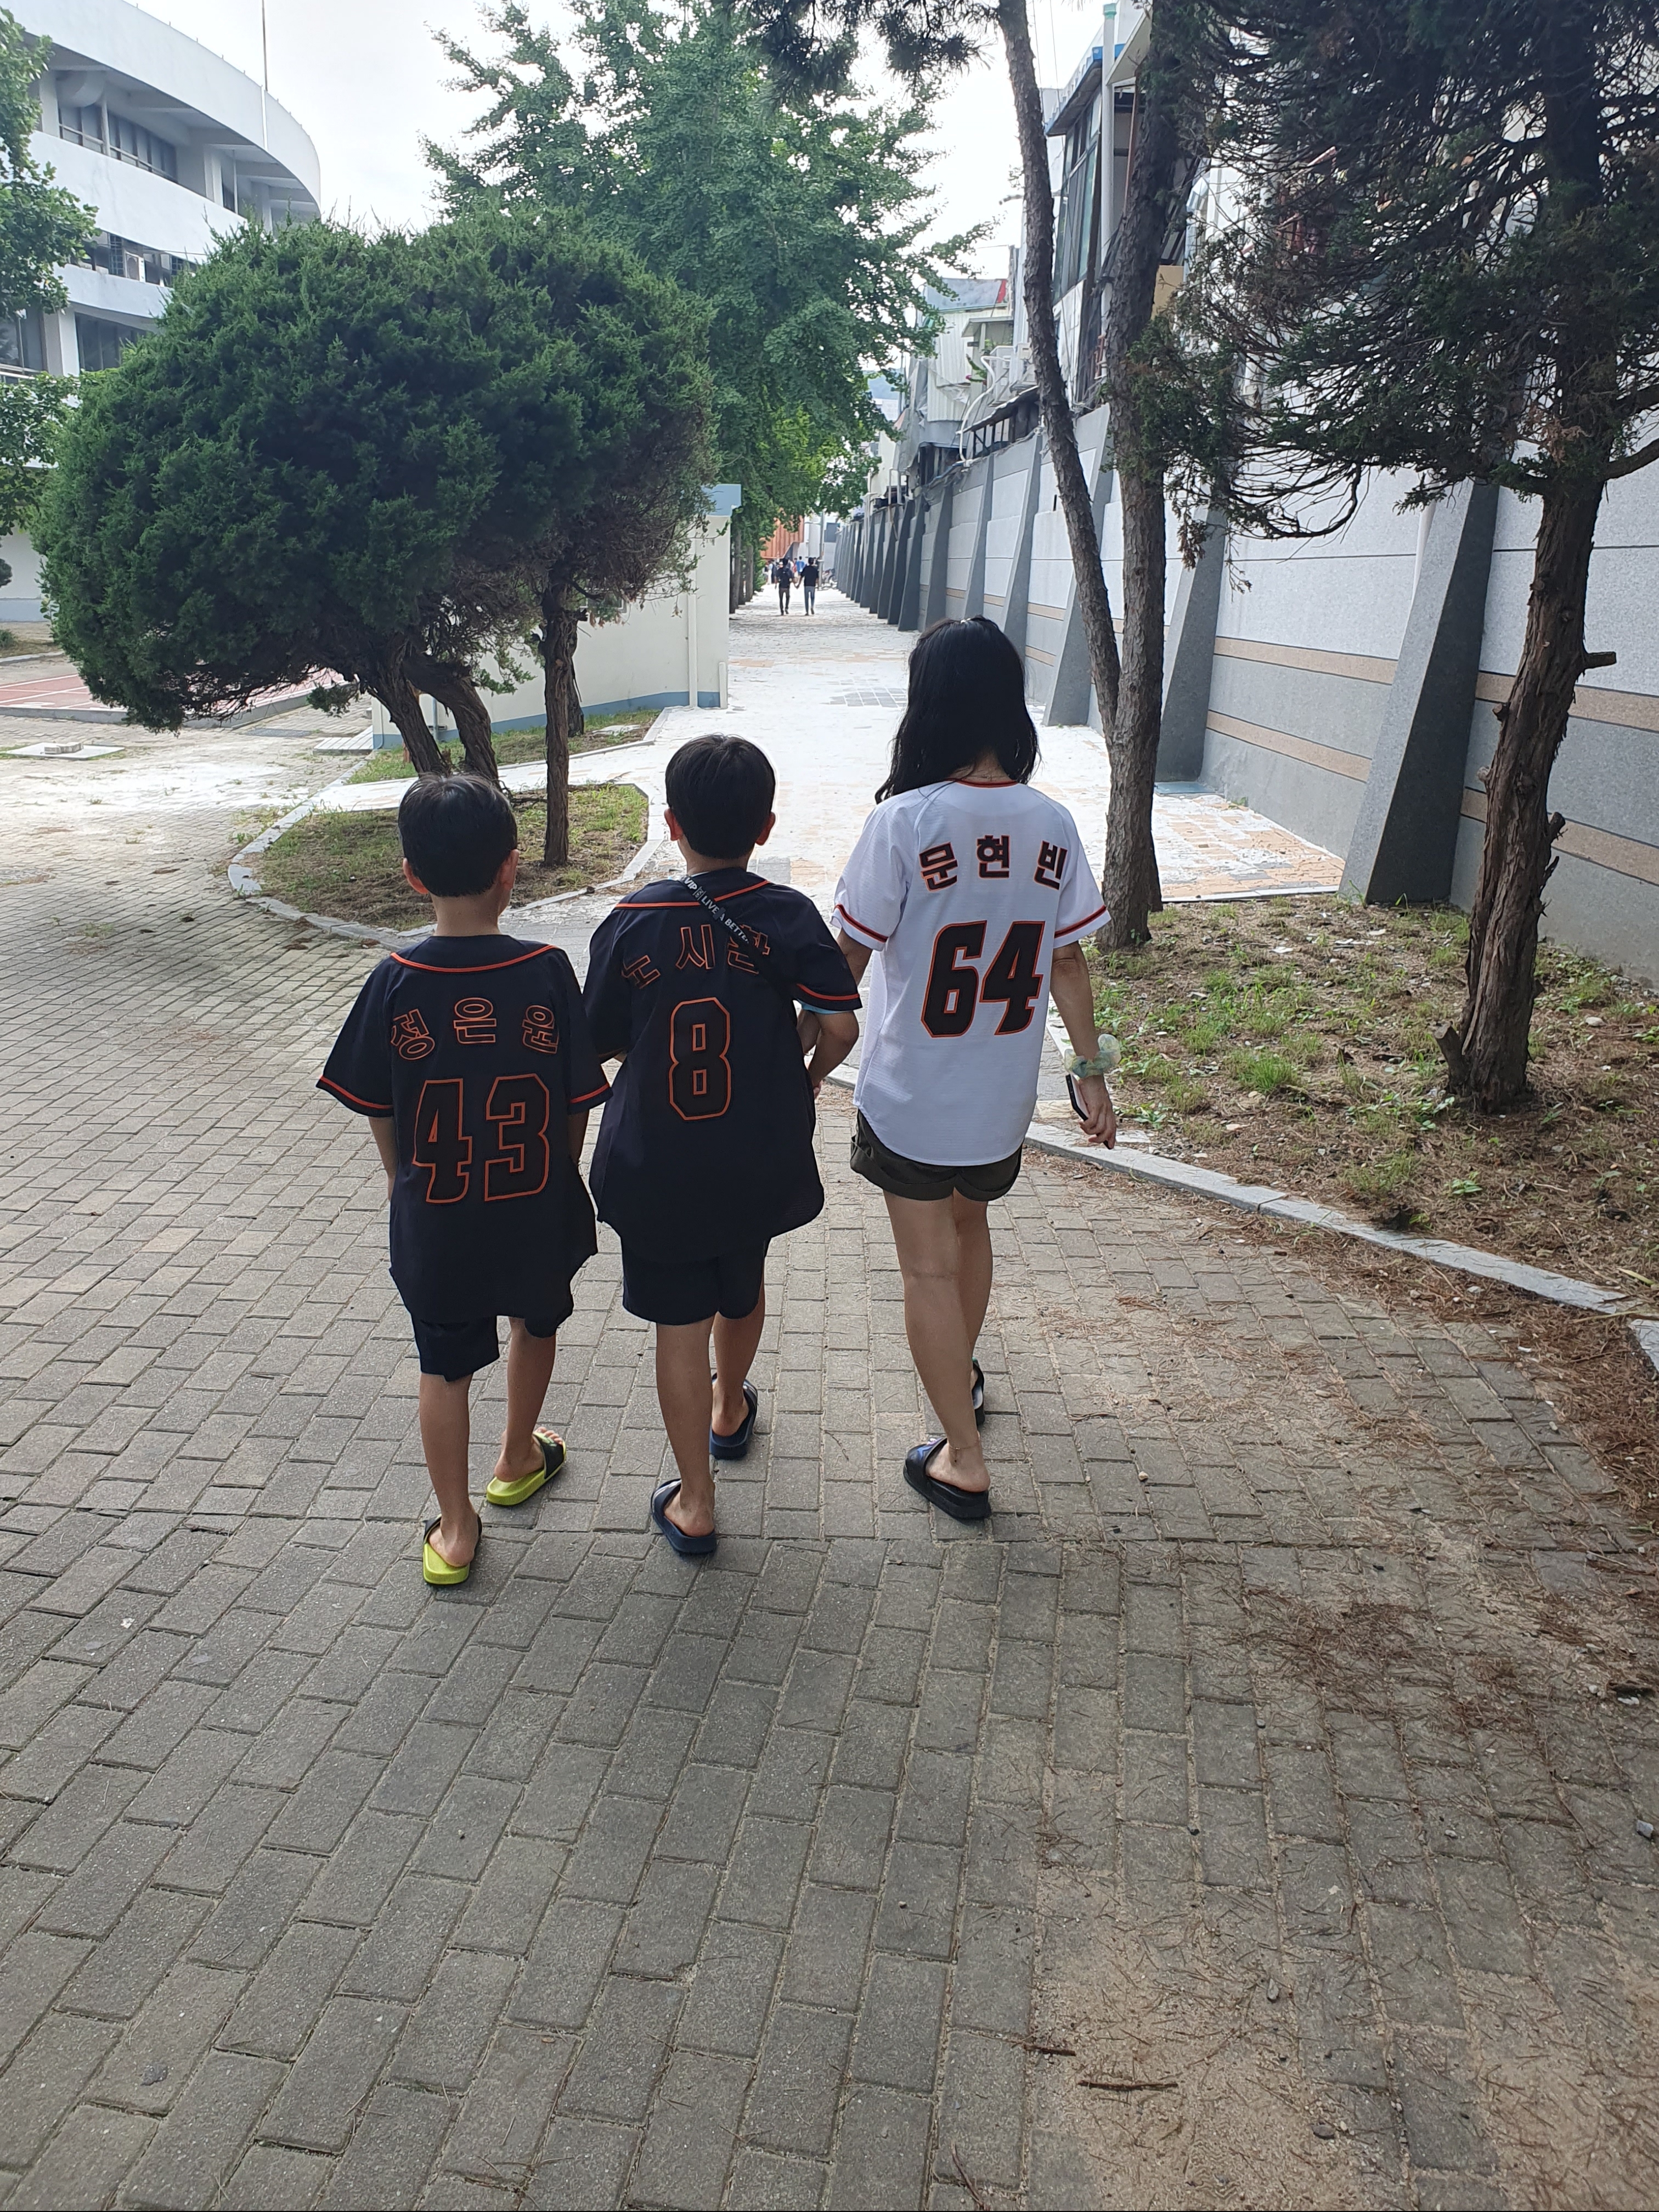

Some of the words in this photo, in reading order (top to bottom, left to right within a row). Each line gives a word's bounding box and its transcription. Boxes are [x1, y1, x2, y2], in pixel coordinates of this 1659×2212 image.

[701, 895, 719, 915] LIVE
[919, 835, 1068, 891] 문현빈
[921, 920, 1045, 1038] 64
[669, 997, 731, 1120] 8
[412, 1073, 549, 1204] 43
